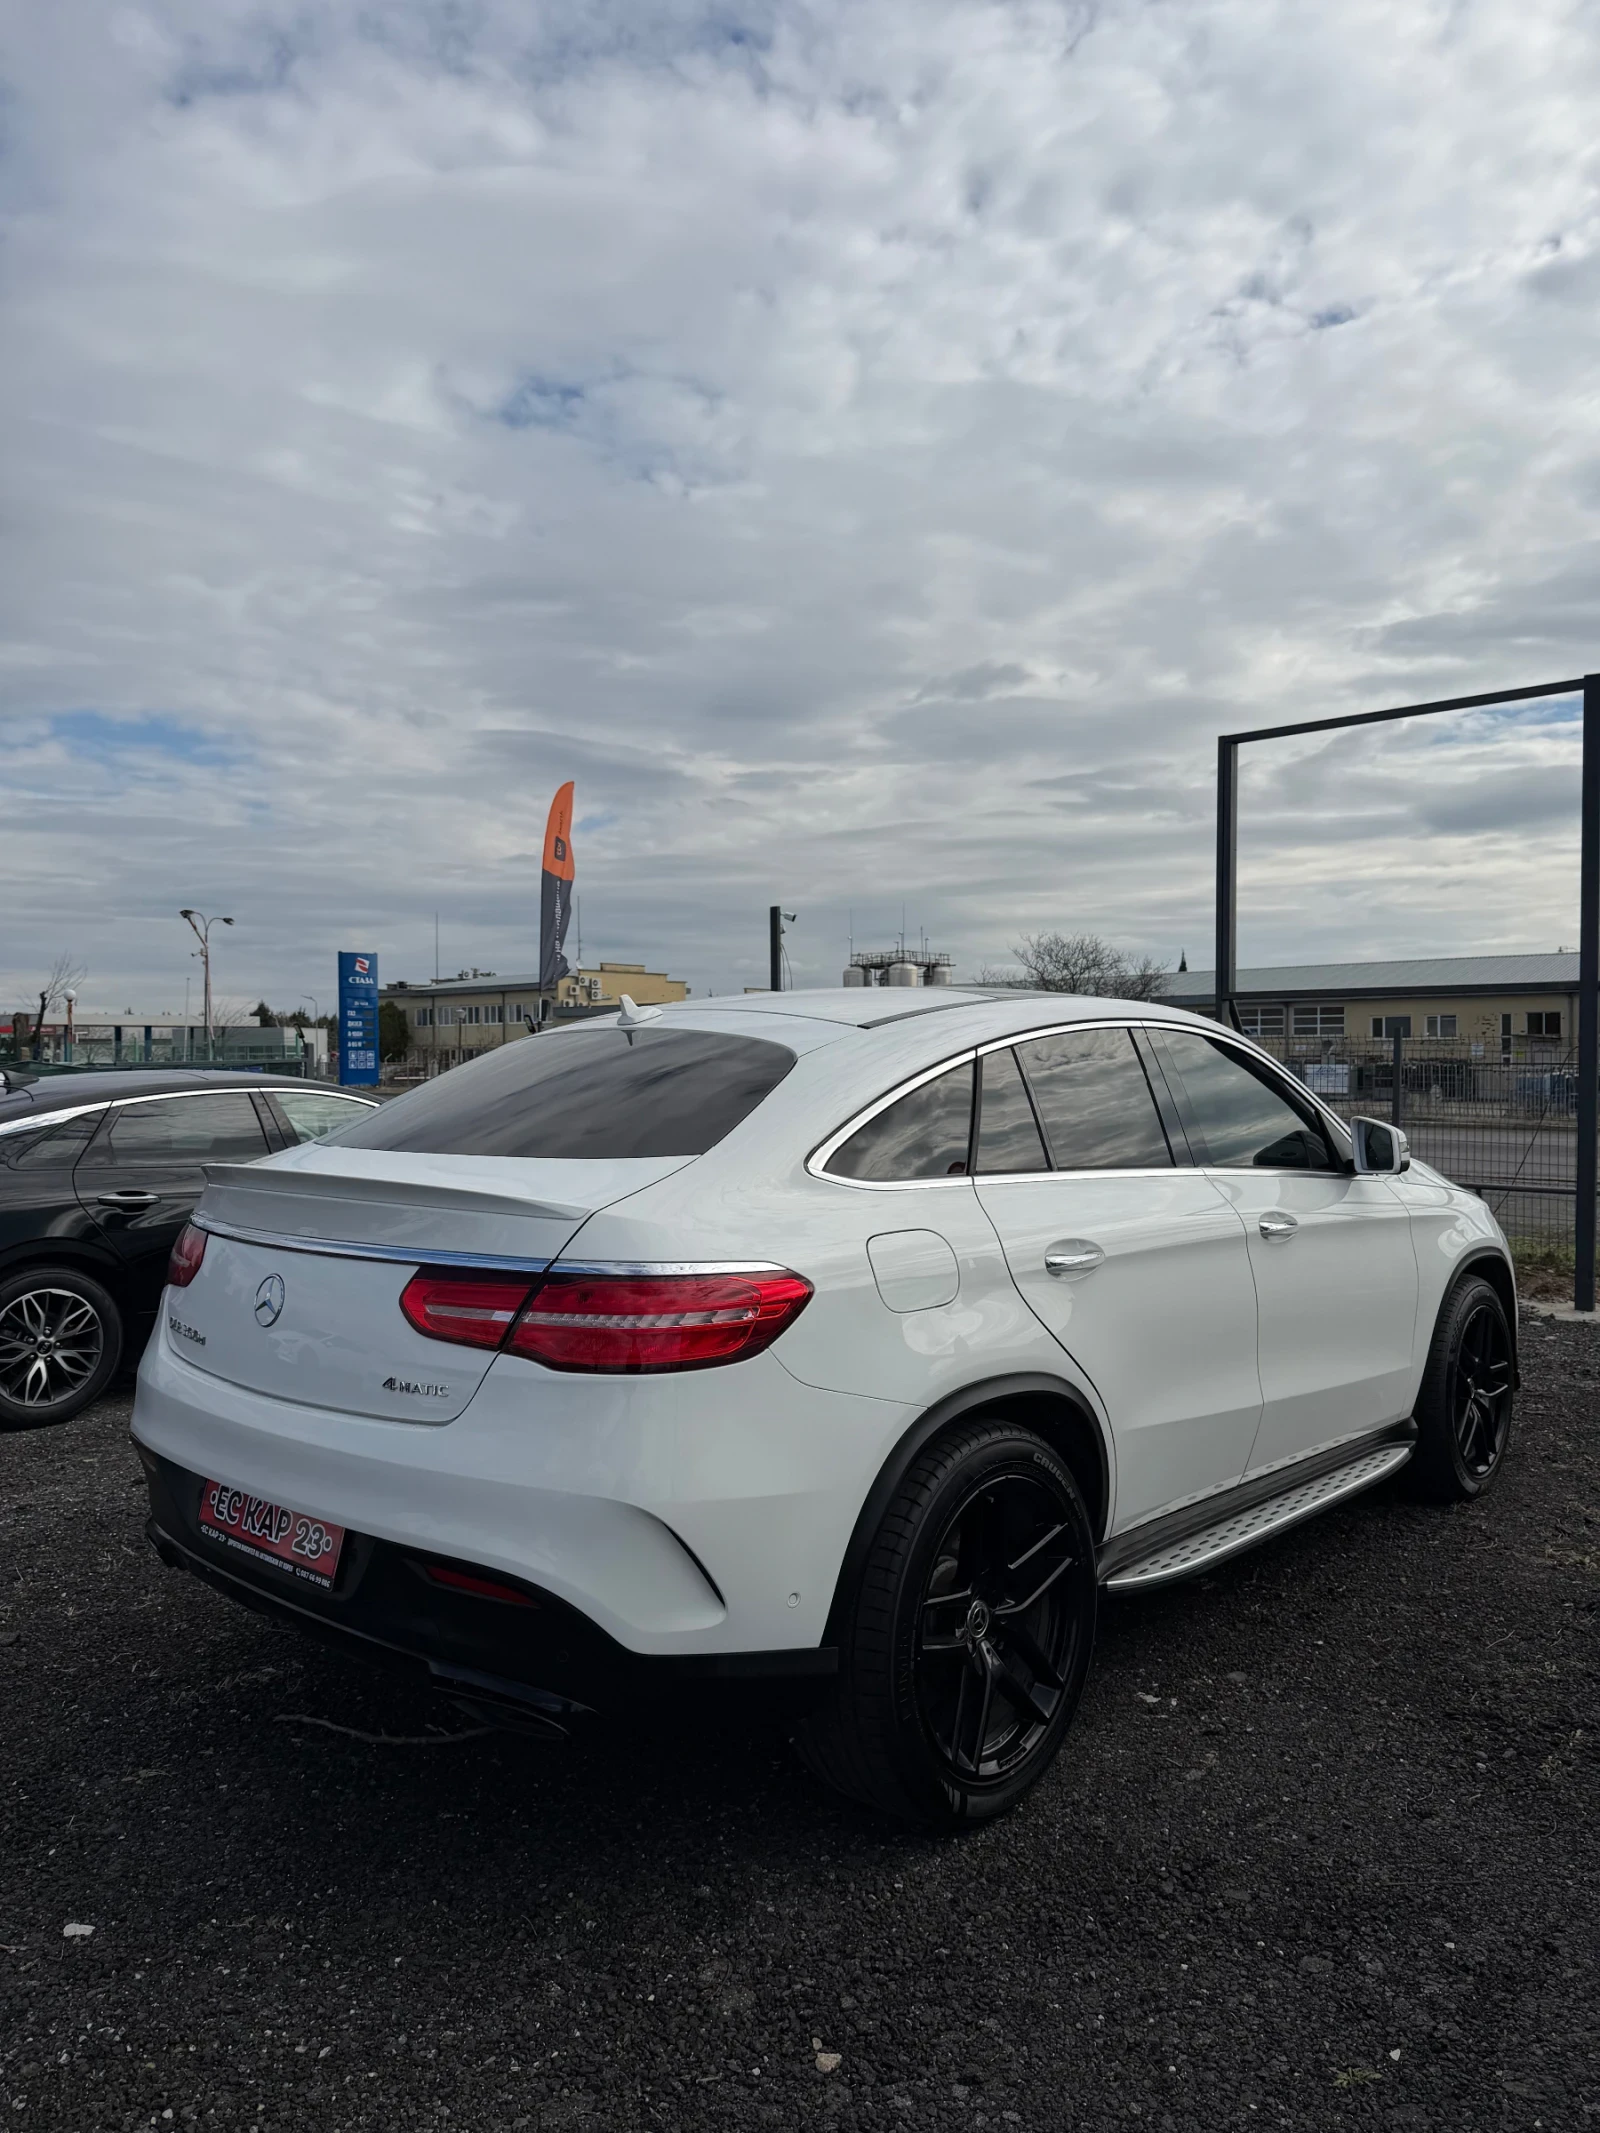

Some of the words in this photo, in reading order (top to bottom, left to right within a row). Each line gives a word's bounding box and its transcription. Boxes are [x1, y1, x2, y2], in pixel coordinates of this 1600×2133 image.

[348, 976, 374, 985] СТАЗА
[382, 1376, 449, 1398] 4MATIC
[1033, 1452, 1076, 1500] CRUGEN
